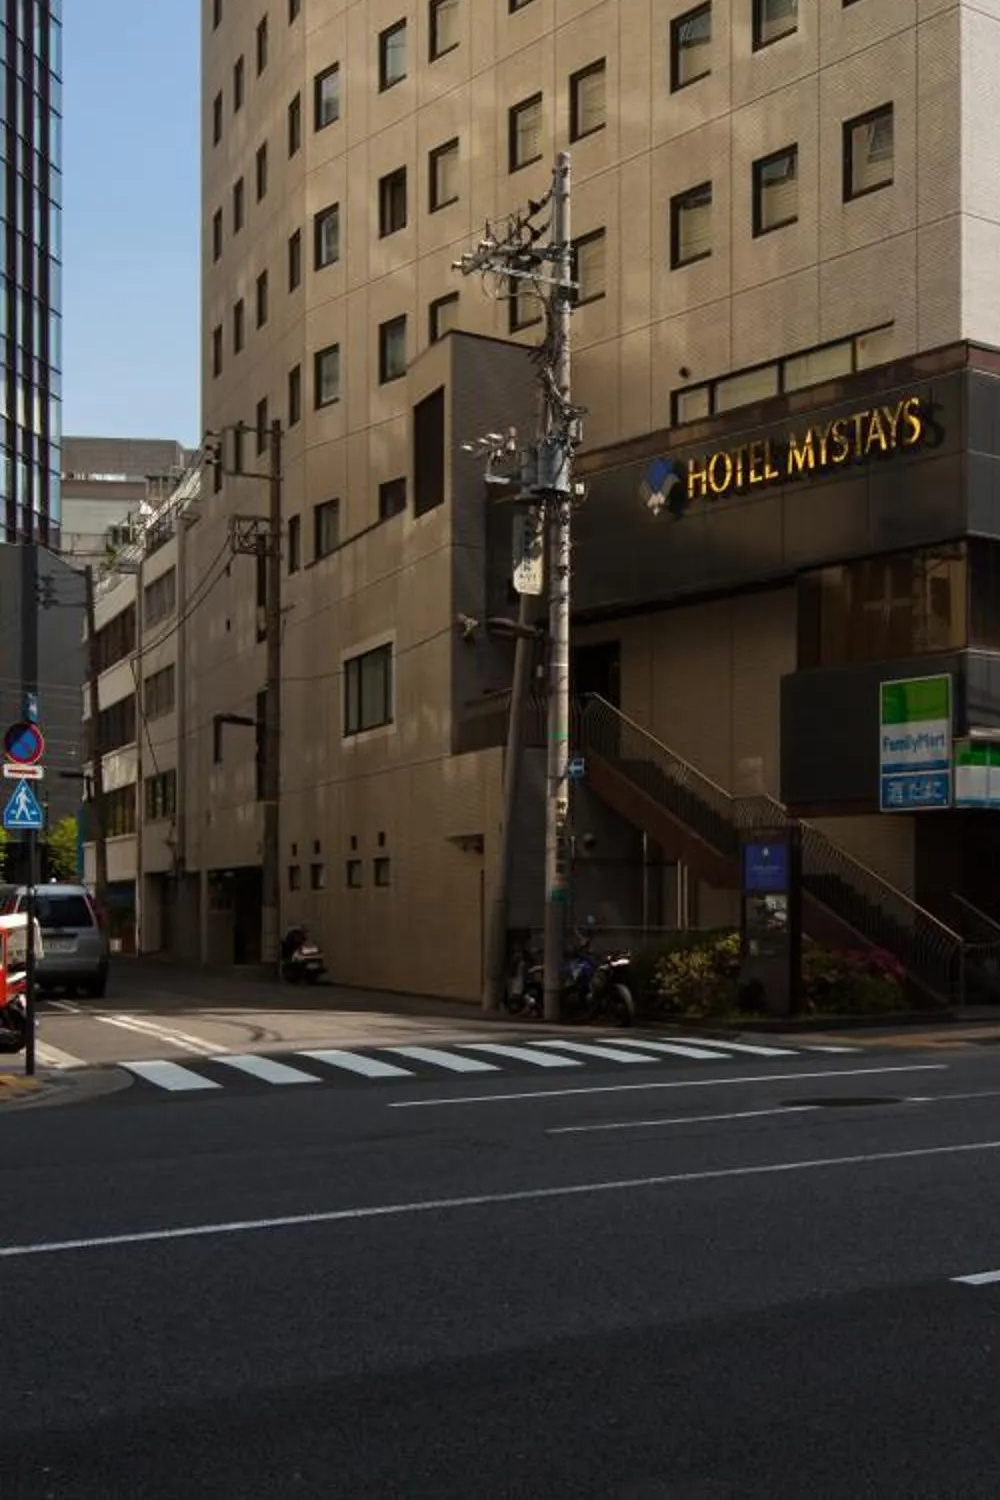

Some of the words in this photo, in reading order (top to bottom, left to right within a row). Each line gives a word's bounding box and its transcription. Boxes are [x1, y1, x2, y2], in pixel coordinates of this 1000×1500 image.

[687, 439, 779, 499] HOTEL
[787, 397, 921, 475] MYSTAYS
[883, 731, 945, 754] FamilyMart
